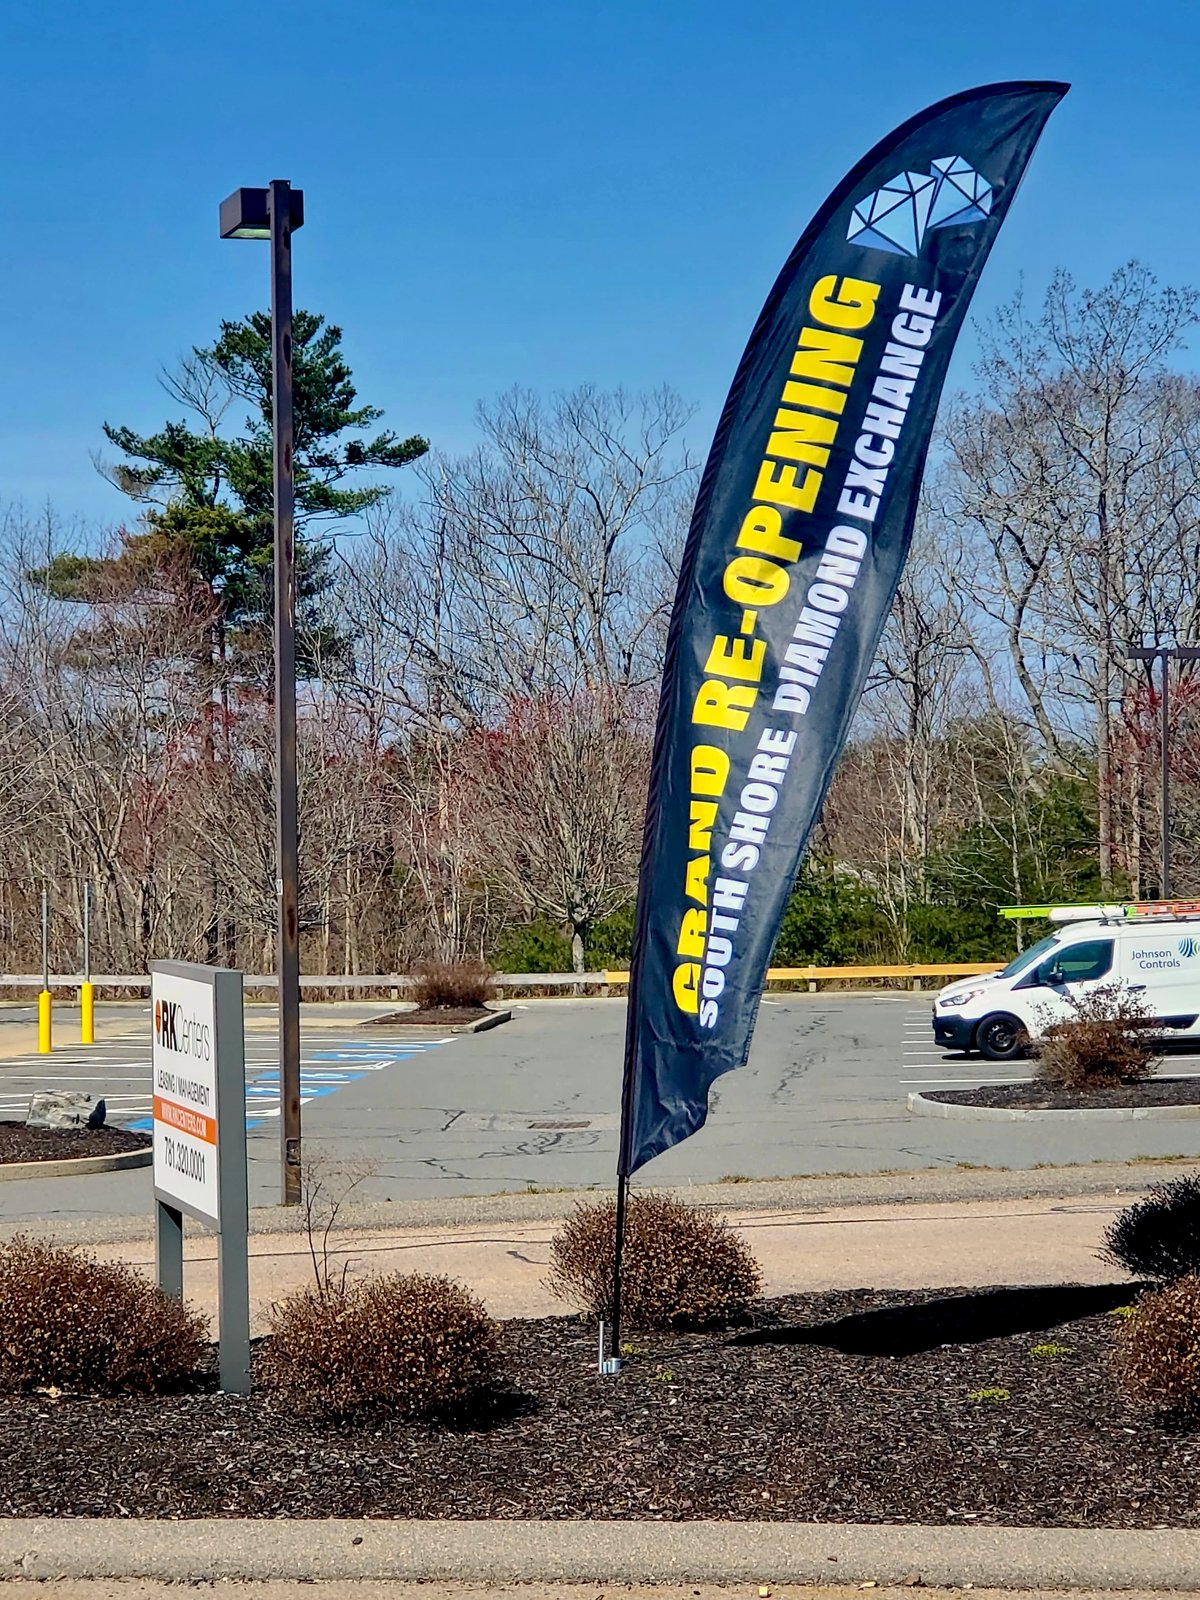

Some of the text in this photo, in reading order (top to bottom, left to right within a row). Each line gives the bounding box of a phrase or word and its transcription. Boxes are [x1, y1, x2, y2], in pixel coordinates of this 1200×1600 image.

[672, 274, 882, 1015] GRAND RE-OPENING
[699, 283, 942, 1030] SOUTH SHORE DIAMOND EXCHANGE
[1131, 949, 1172, 961] Johnson
[1139, 958, 1181, 970] Controls
[157, 1069, 175, 1094] LEASING
[178, 1077, 210, 1107] MANAGEMENT
[164, 1136, 206, 1184] 781.320.0001
